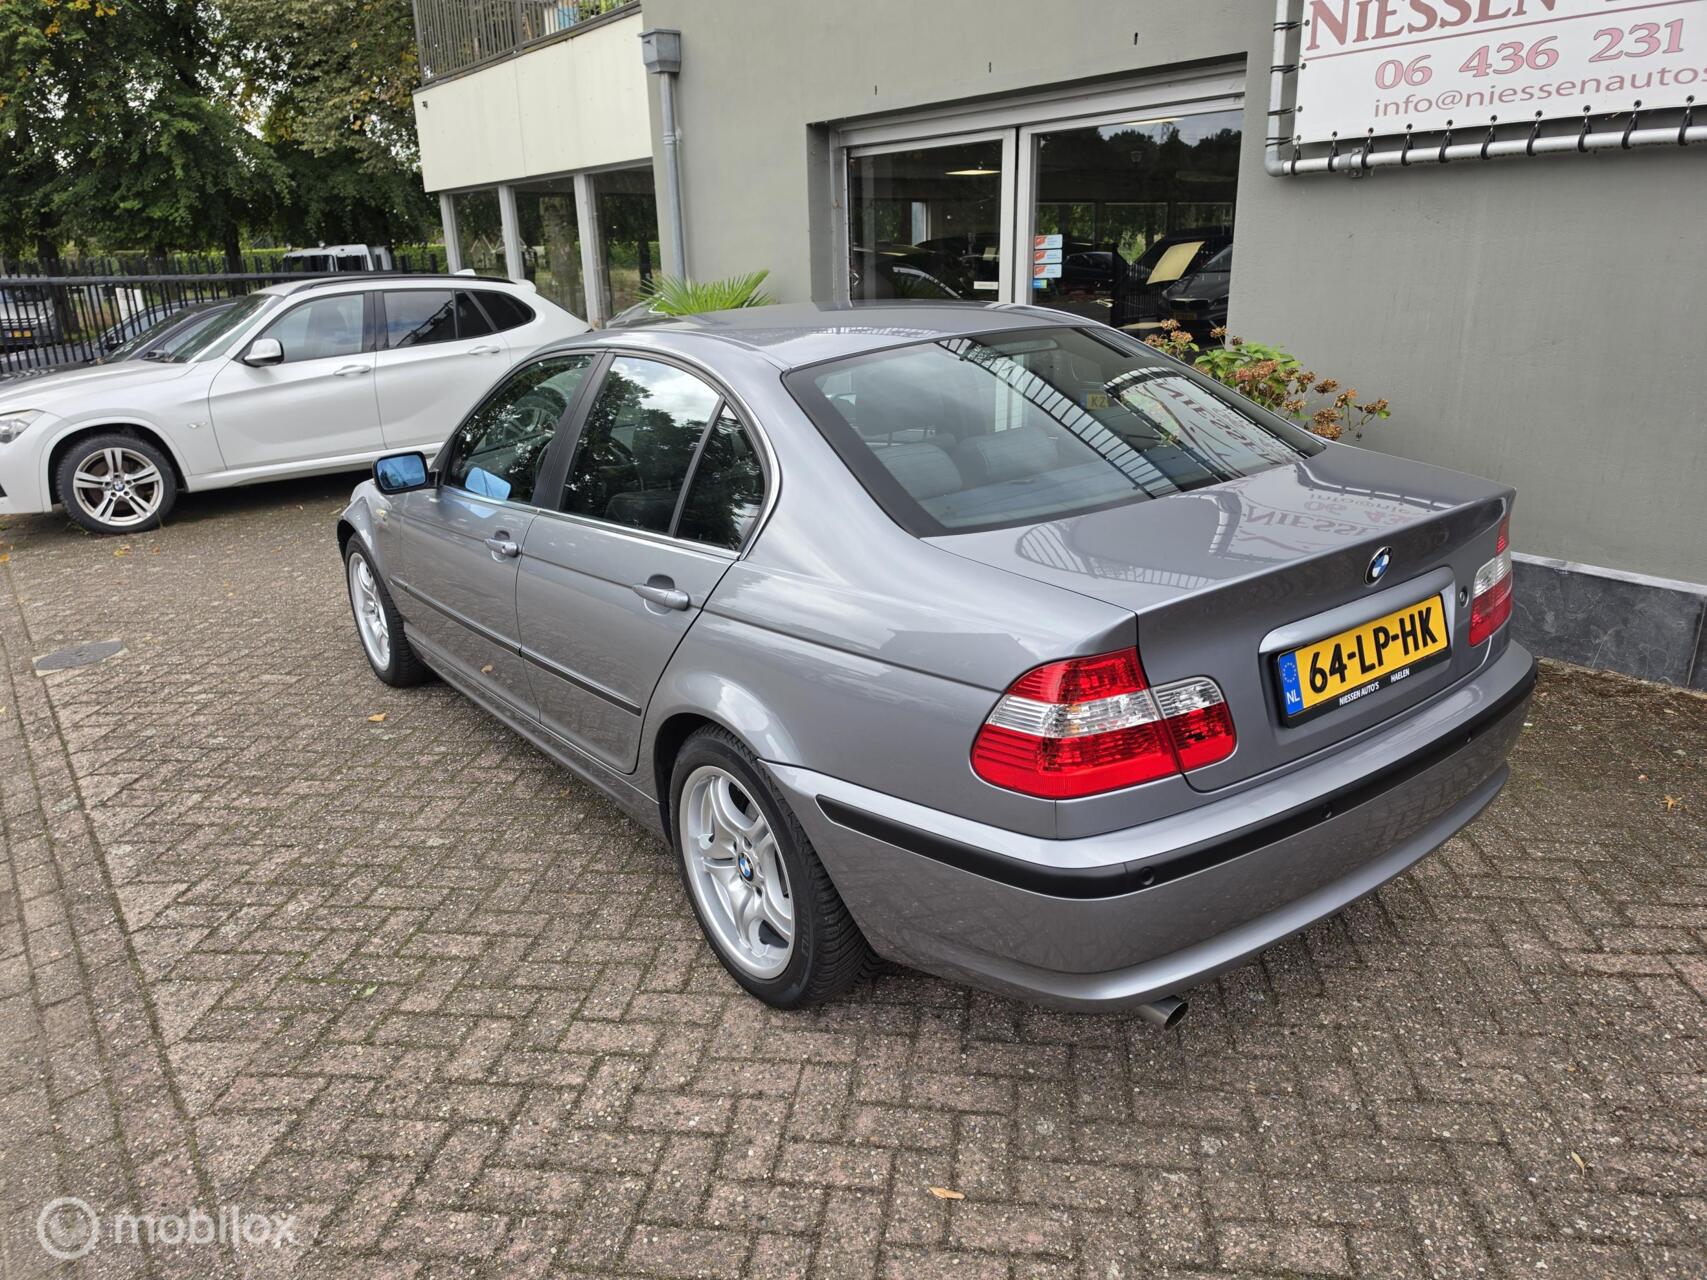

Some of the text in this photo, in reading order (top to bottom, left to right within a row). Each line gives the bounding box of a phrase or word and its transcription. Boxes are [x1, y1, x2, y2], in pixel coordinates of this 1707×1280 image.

[1374, 18, 1685, 91] 06 436 231
[1308, 606, 1438, 695] 64-LP-HK
[1286, 688, 1300, 705] NL
[1339, 689, 1361, 706] NIESSEN
[1390, 667, 1410, 684] HAELEN
